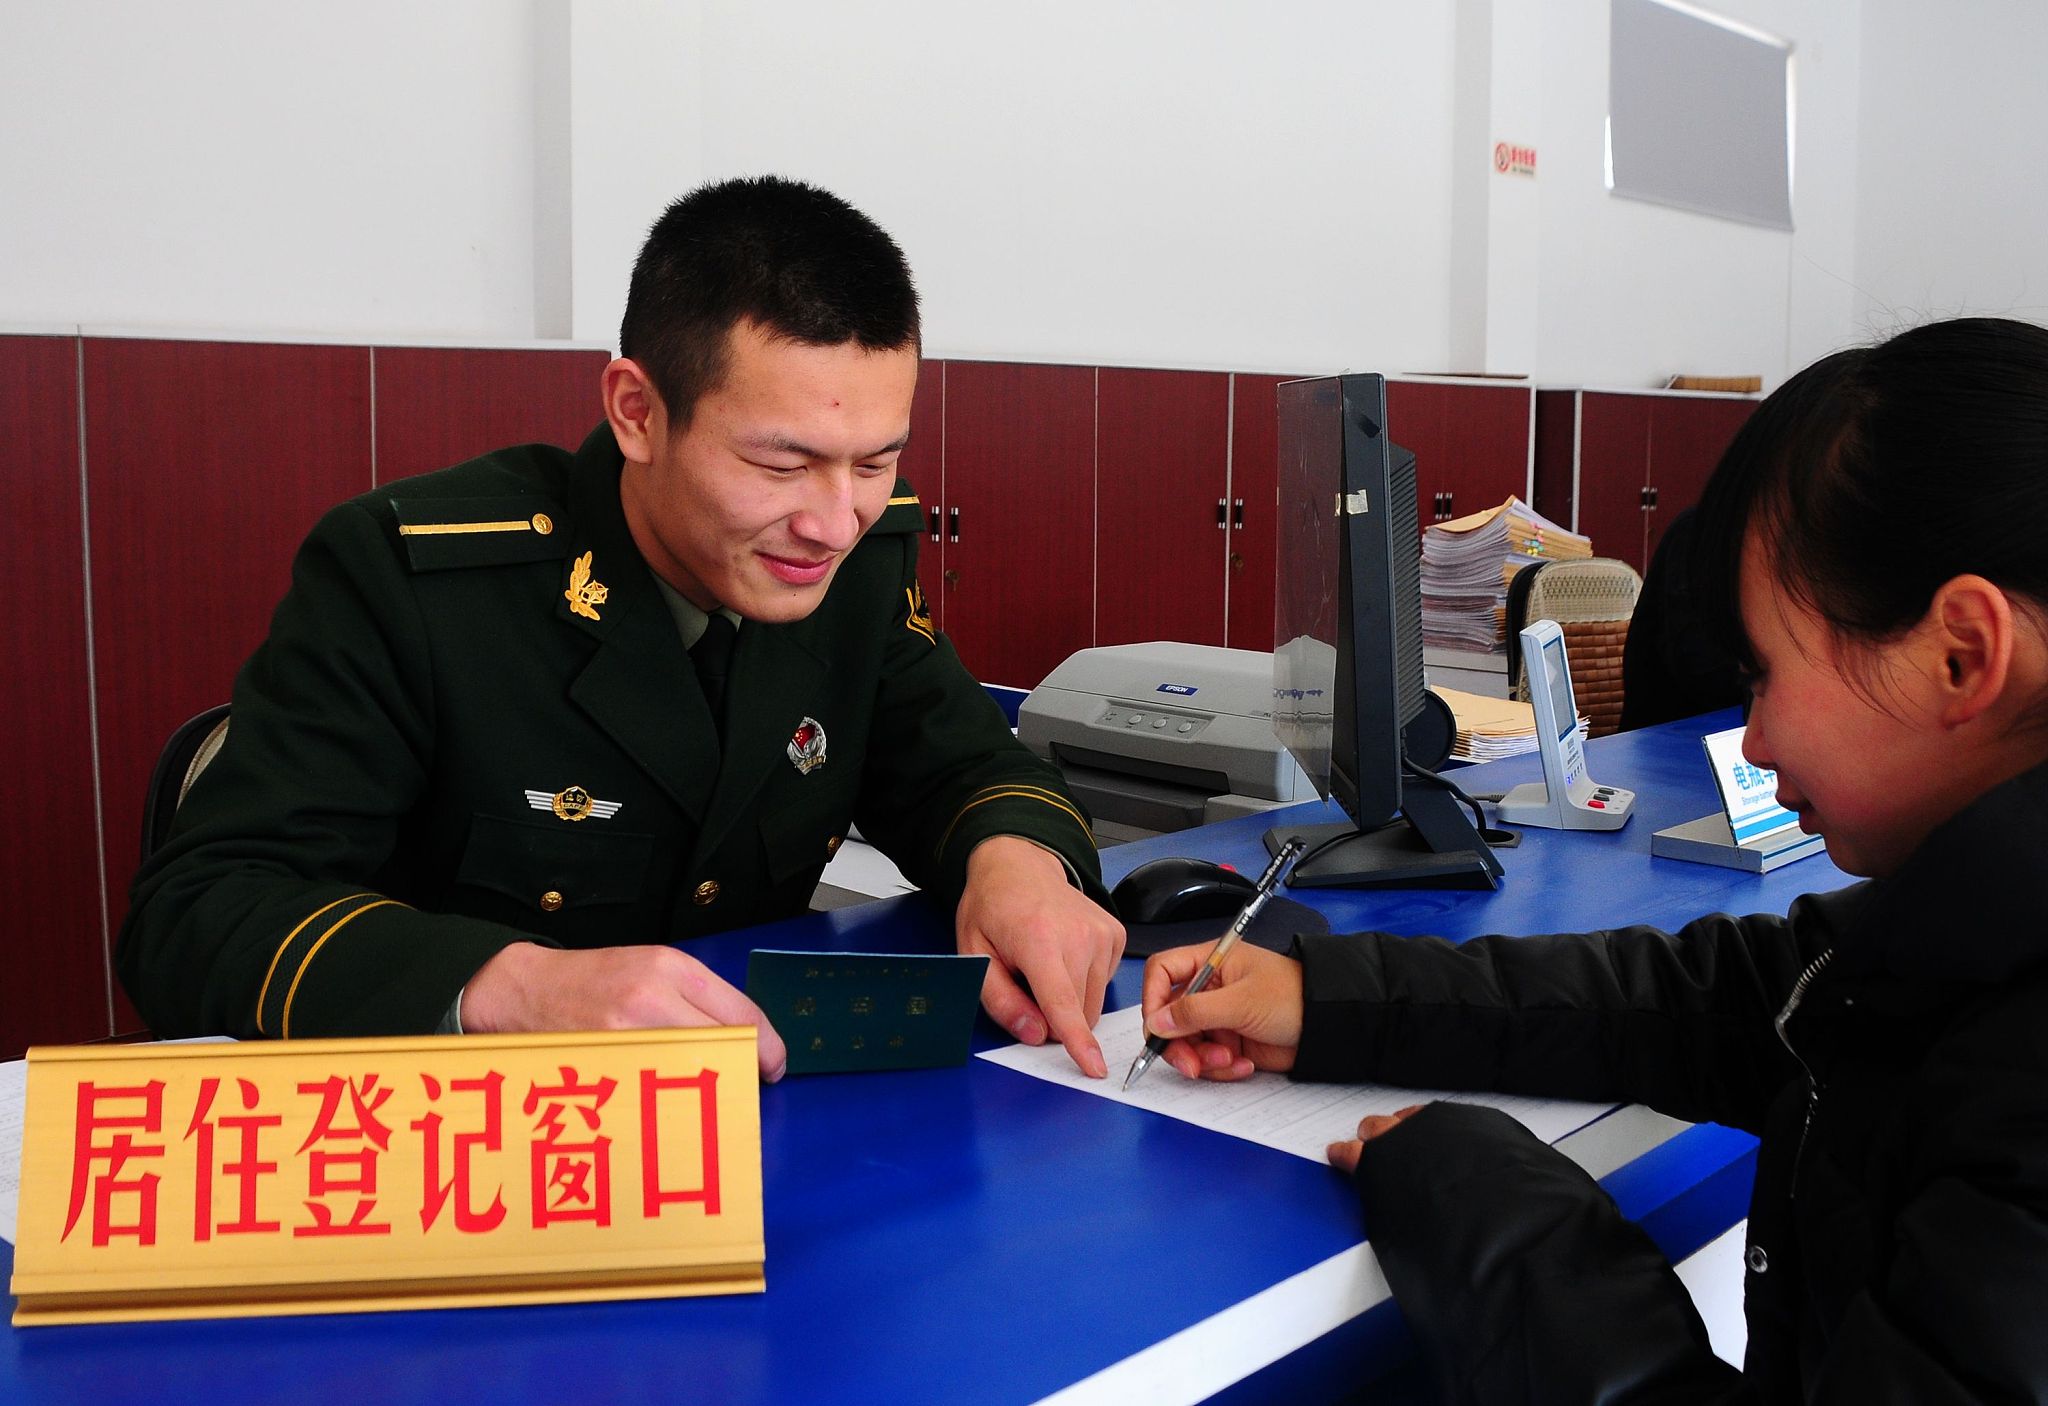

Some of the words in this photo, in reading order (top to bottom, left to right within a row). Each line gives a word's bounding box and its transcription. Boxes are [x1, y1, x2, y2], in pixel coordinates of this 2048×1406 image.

[1165, 685, 1189, 693] EPSON
[61, 1067, 722, 1247] 居住登记窗口
